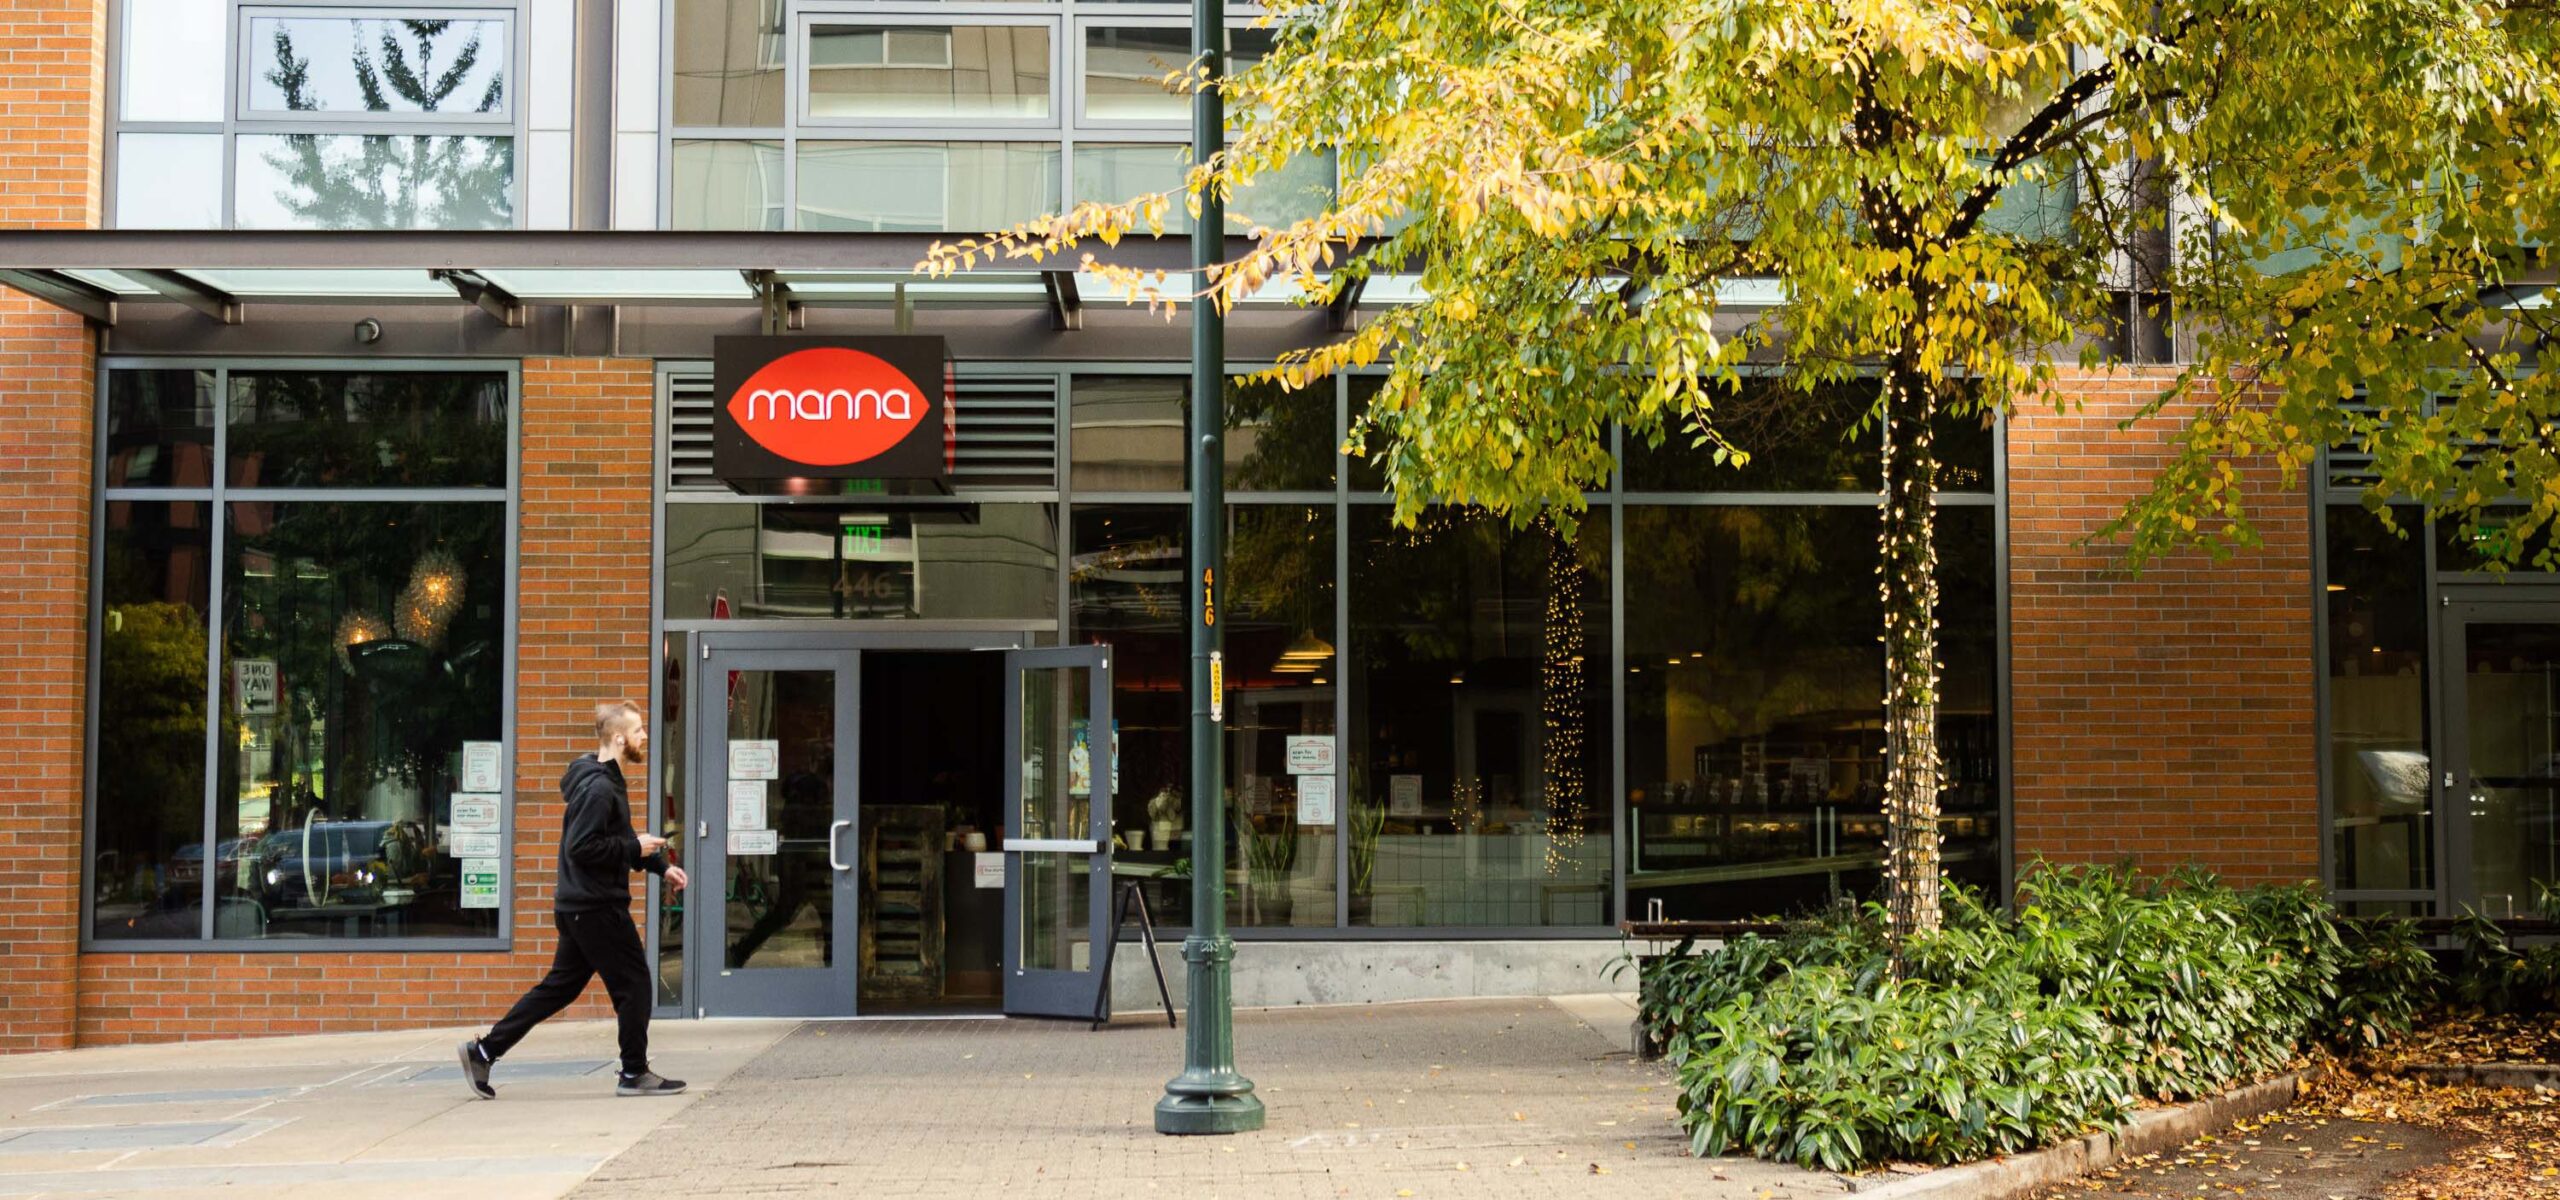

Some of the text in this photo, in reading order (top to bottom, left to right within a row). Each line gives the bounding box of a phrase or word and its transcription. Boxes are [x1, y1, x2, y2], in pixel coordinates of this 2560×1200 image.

[748, 388, 911, 420] manna
[832, 572, 892, 599] 446
[1204, 568, 1215, 626] 416
